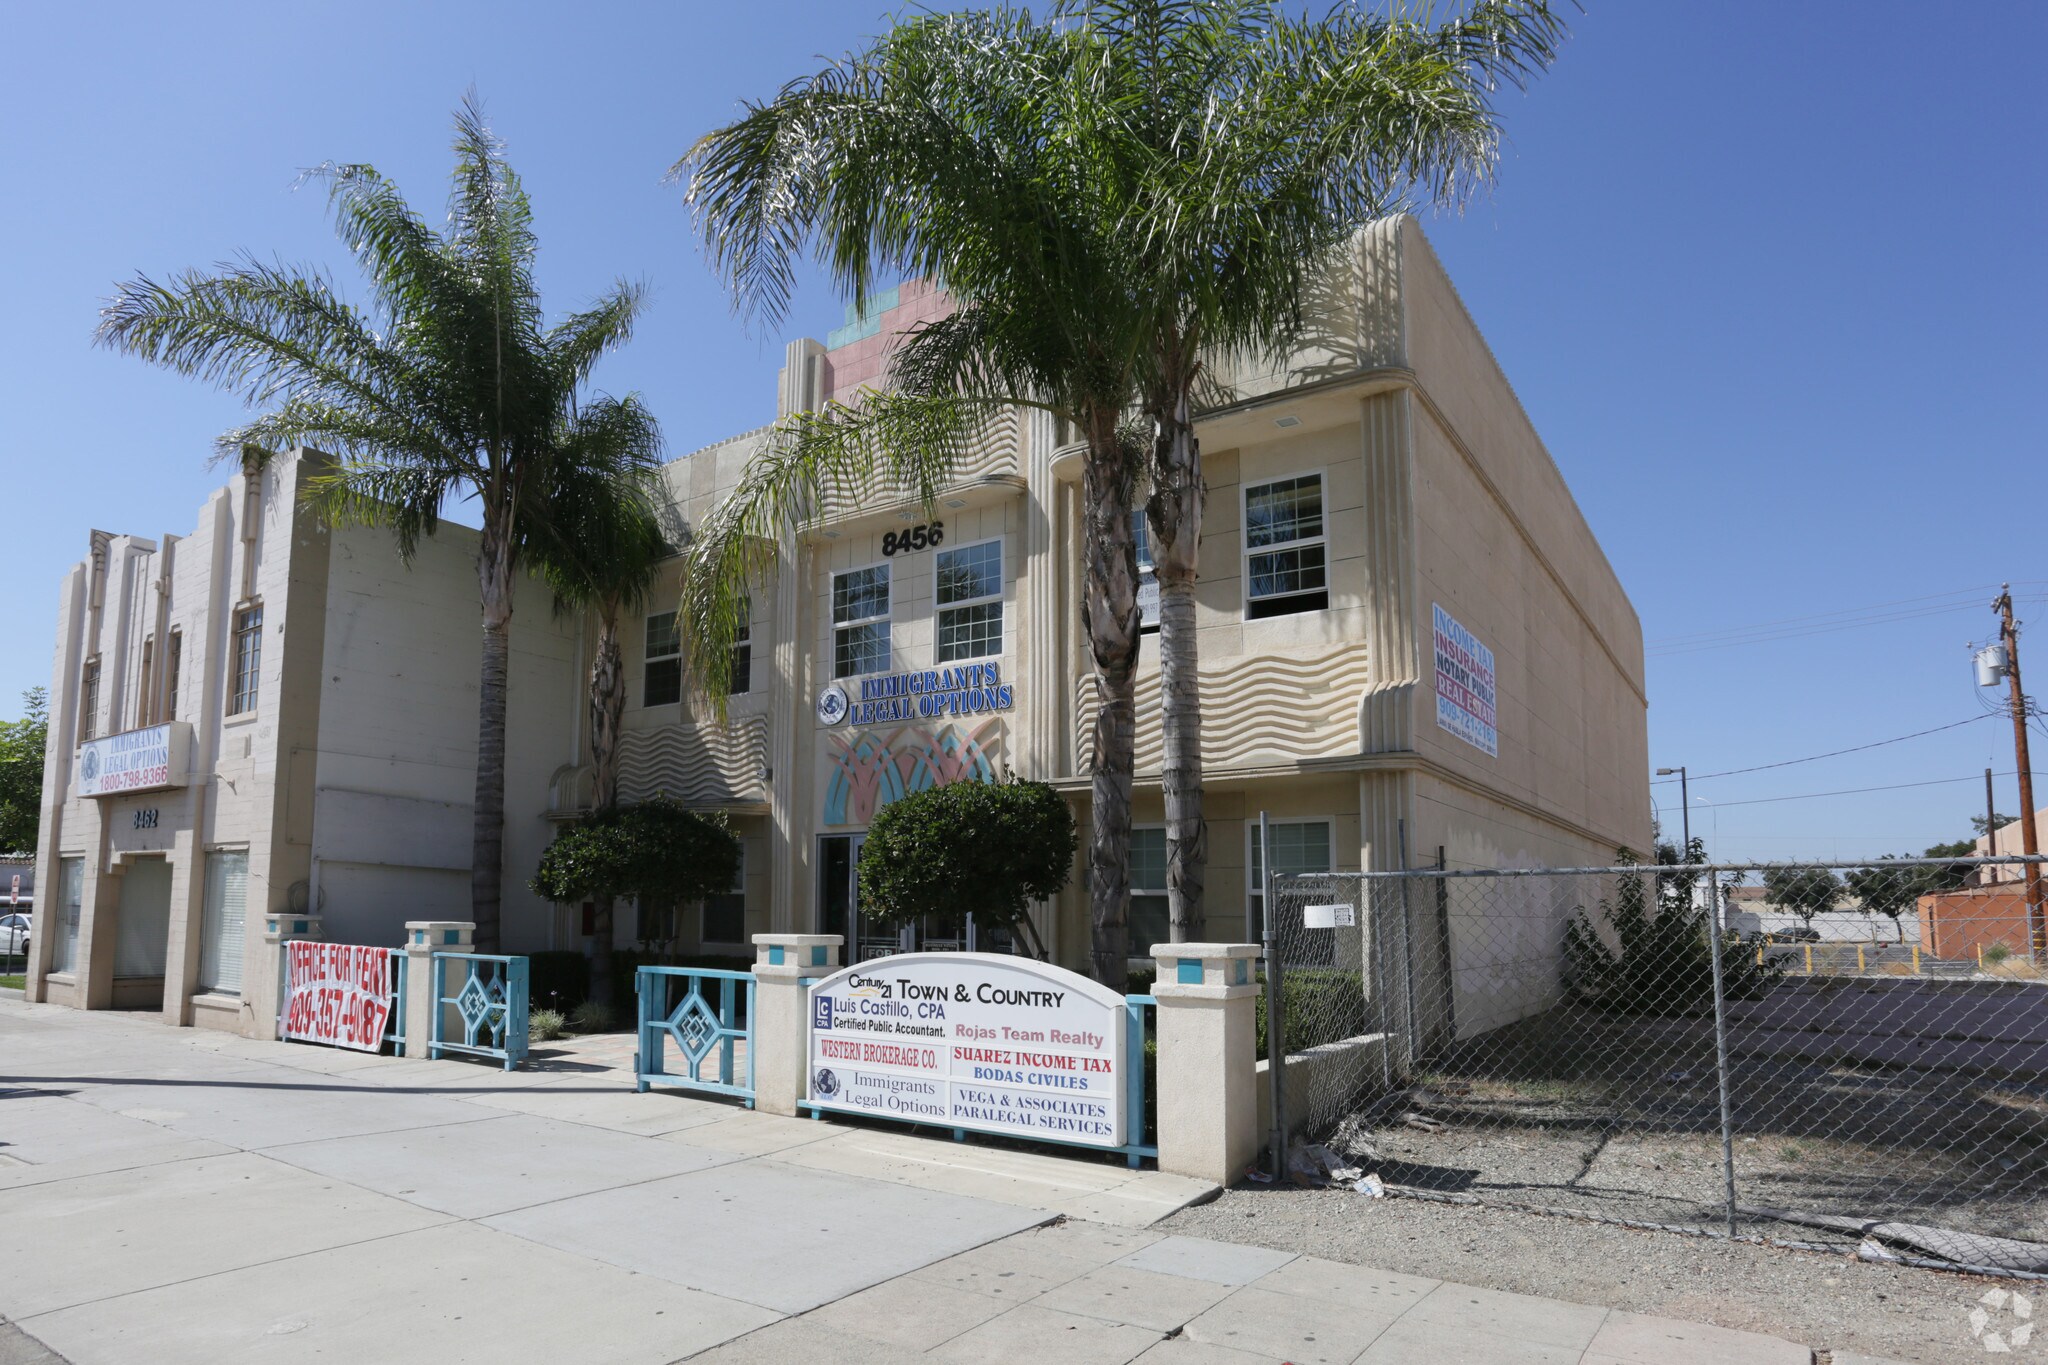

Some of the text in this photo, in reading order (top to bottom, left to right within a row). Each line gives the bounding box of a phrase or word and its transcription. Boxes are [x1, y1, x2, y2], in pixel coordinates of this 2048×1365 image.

[882, 521, 944, 557] 8456
[1434, 605, 1494, 674] INCOME TAX
[1435, 629, 1494, 691] INSURANCE
[861, 661, 998, 700] IMMIGRANTS
[1436, 650, 1495, 708] NOTARY PUBLIC
[850, 696, 914, 726] LEGAL
[918, 684, 1013, 718] OPTIONS
[1438, 674, 1496, 727] REAL ESTATE
[110, 727, 162, 754] IMMIGRANTS
[104, 746, 167, 774] LEGAL OPTIONS
[100, 765, 168, 791] 1800-798-9366
[133, 808, 159, 829] 8462
[290, 941, 326, 991] OFFICE
[329, 944, 351, 982] FOR
[868, 948, 893, 958] FOR
[849, 974, 1065, 1008] Century 21 TOWN & COUNTRY
[287, 987, 388, 1046] 909-357-9087
[834, 997, 946, 1020] Luis Castillo, CPA
[816, 1019, 829, 1028] CPA
[834, 1017, 946, 1038] Certified Public Accountant.
[955, 1024, 1104, 1050] Rojas Team Realty
[821, 1039, 938, 1069] WESTERN BROKERAGE CO.
[954, 1046, 1112, 1073] SUAREZ INCOME TAX
[854, 1072, 936, 1095] Immigrants
[974, 1066, 1088, 1090] BODAS CIVILES
[845, 1090, 946, 1117] Legal Options
[959, 1089, 1106, 1118] VEGA & ASSOCIATES
[954, 1104, 1112, 1136] PARALEGAL SERVICES
